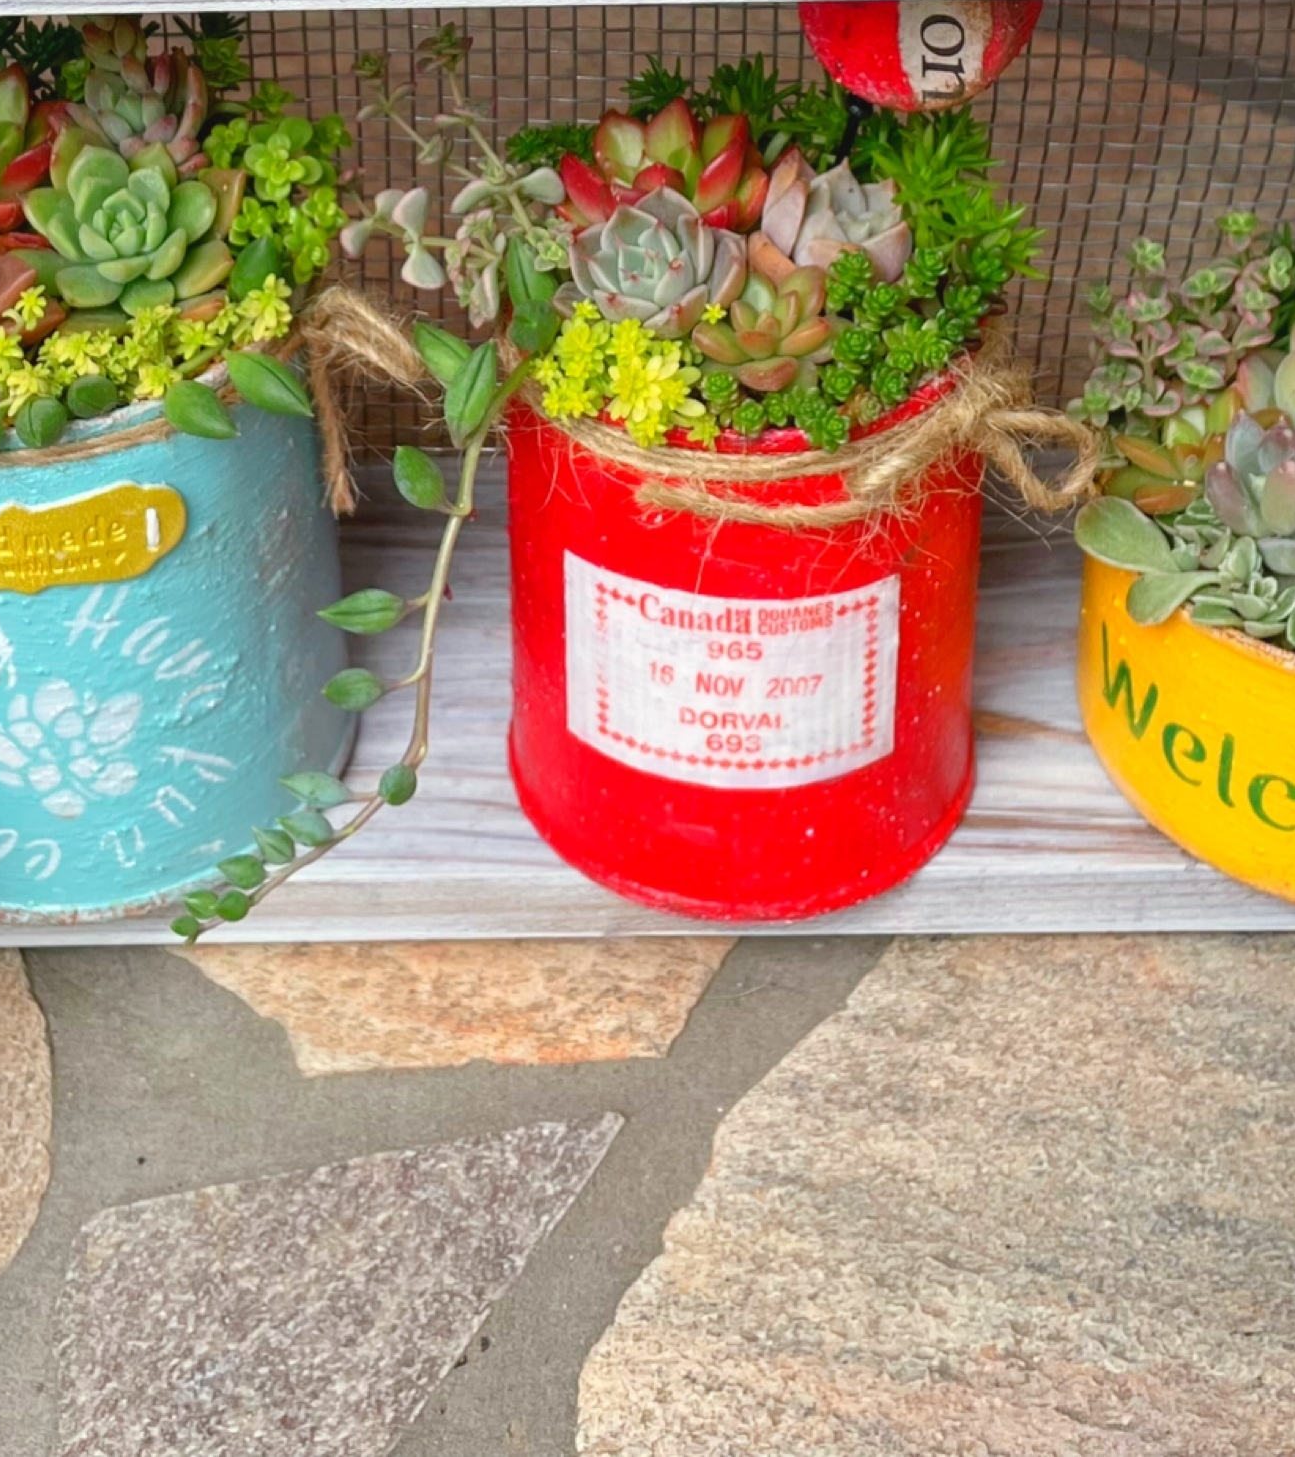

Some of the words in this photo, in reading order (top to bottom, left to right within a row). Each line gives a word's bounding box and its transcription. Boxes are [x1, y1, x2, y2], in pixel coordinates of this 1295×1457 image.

[638, 593, 751, 635] Canada
[758, 601, 835, 622] DOUANES
[758, 614, 834, 636] CUSTOMS
[707, 641, 764, 661] 965
[695, 671, 745, 697] NOV
[766, 674, 823, 698] 2007
[706, 733, 762, 753] 693
